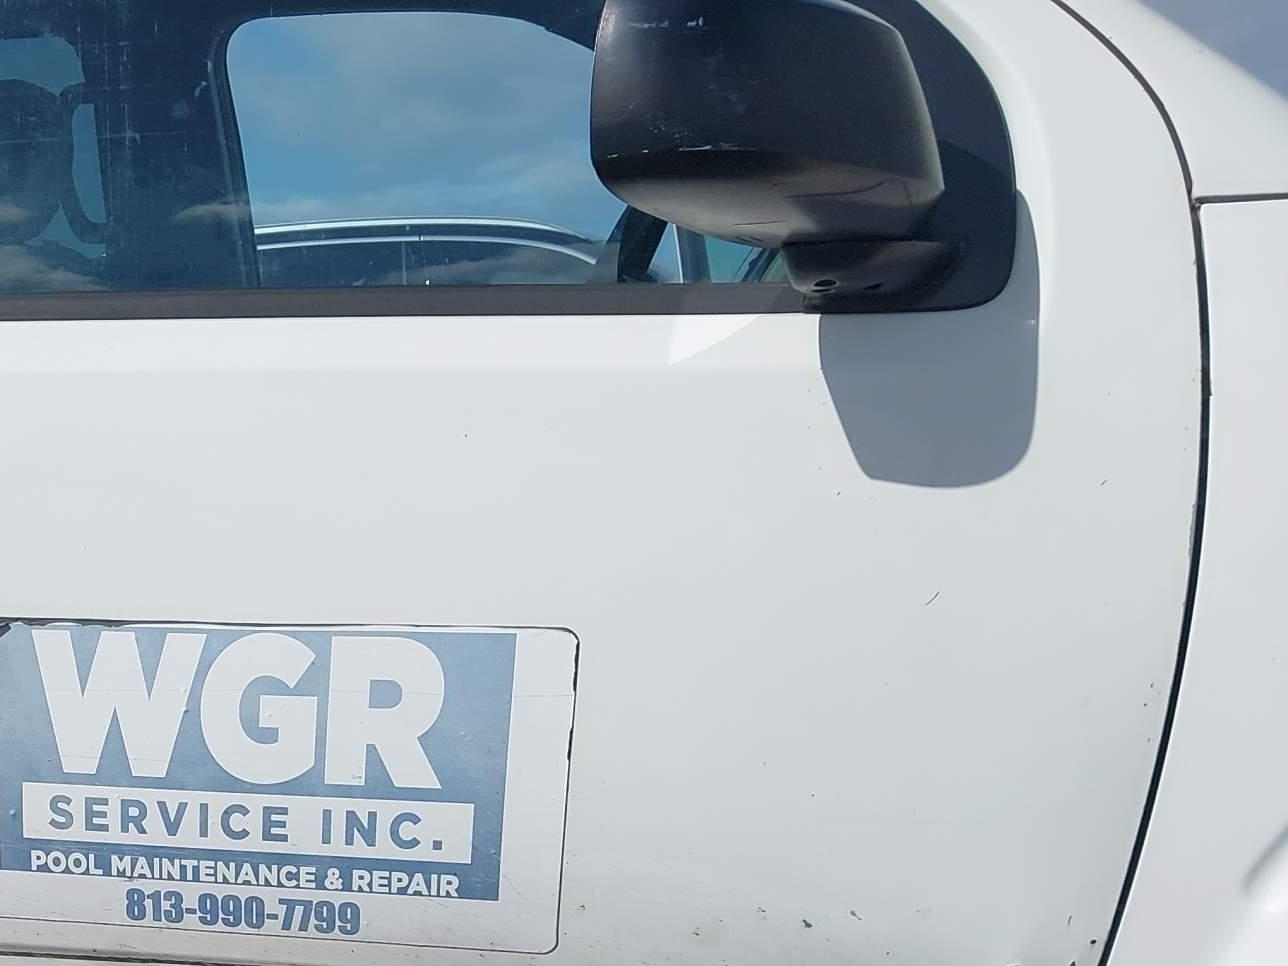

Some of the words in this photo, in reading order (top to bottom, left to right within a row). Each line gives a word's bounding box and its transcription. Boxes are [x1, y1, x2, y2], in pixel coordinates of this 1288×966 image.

[31, 629, 442, 789] WGR
[47, 794, 290, 843] SERVICE
[321, 808, 444, 850] INC.
[30, 849, 106, 876] POOL
[111, 854, 317, 891] MAINTENANCE
[324, 867, 344, 891] &
[352, 869, 460, 898] REPAIR
[126, 889, 362, 936] 813-990-7799
